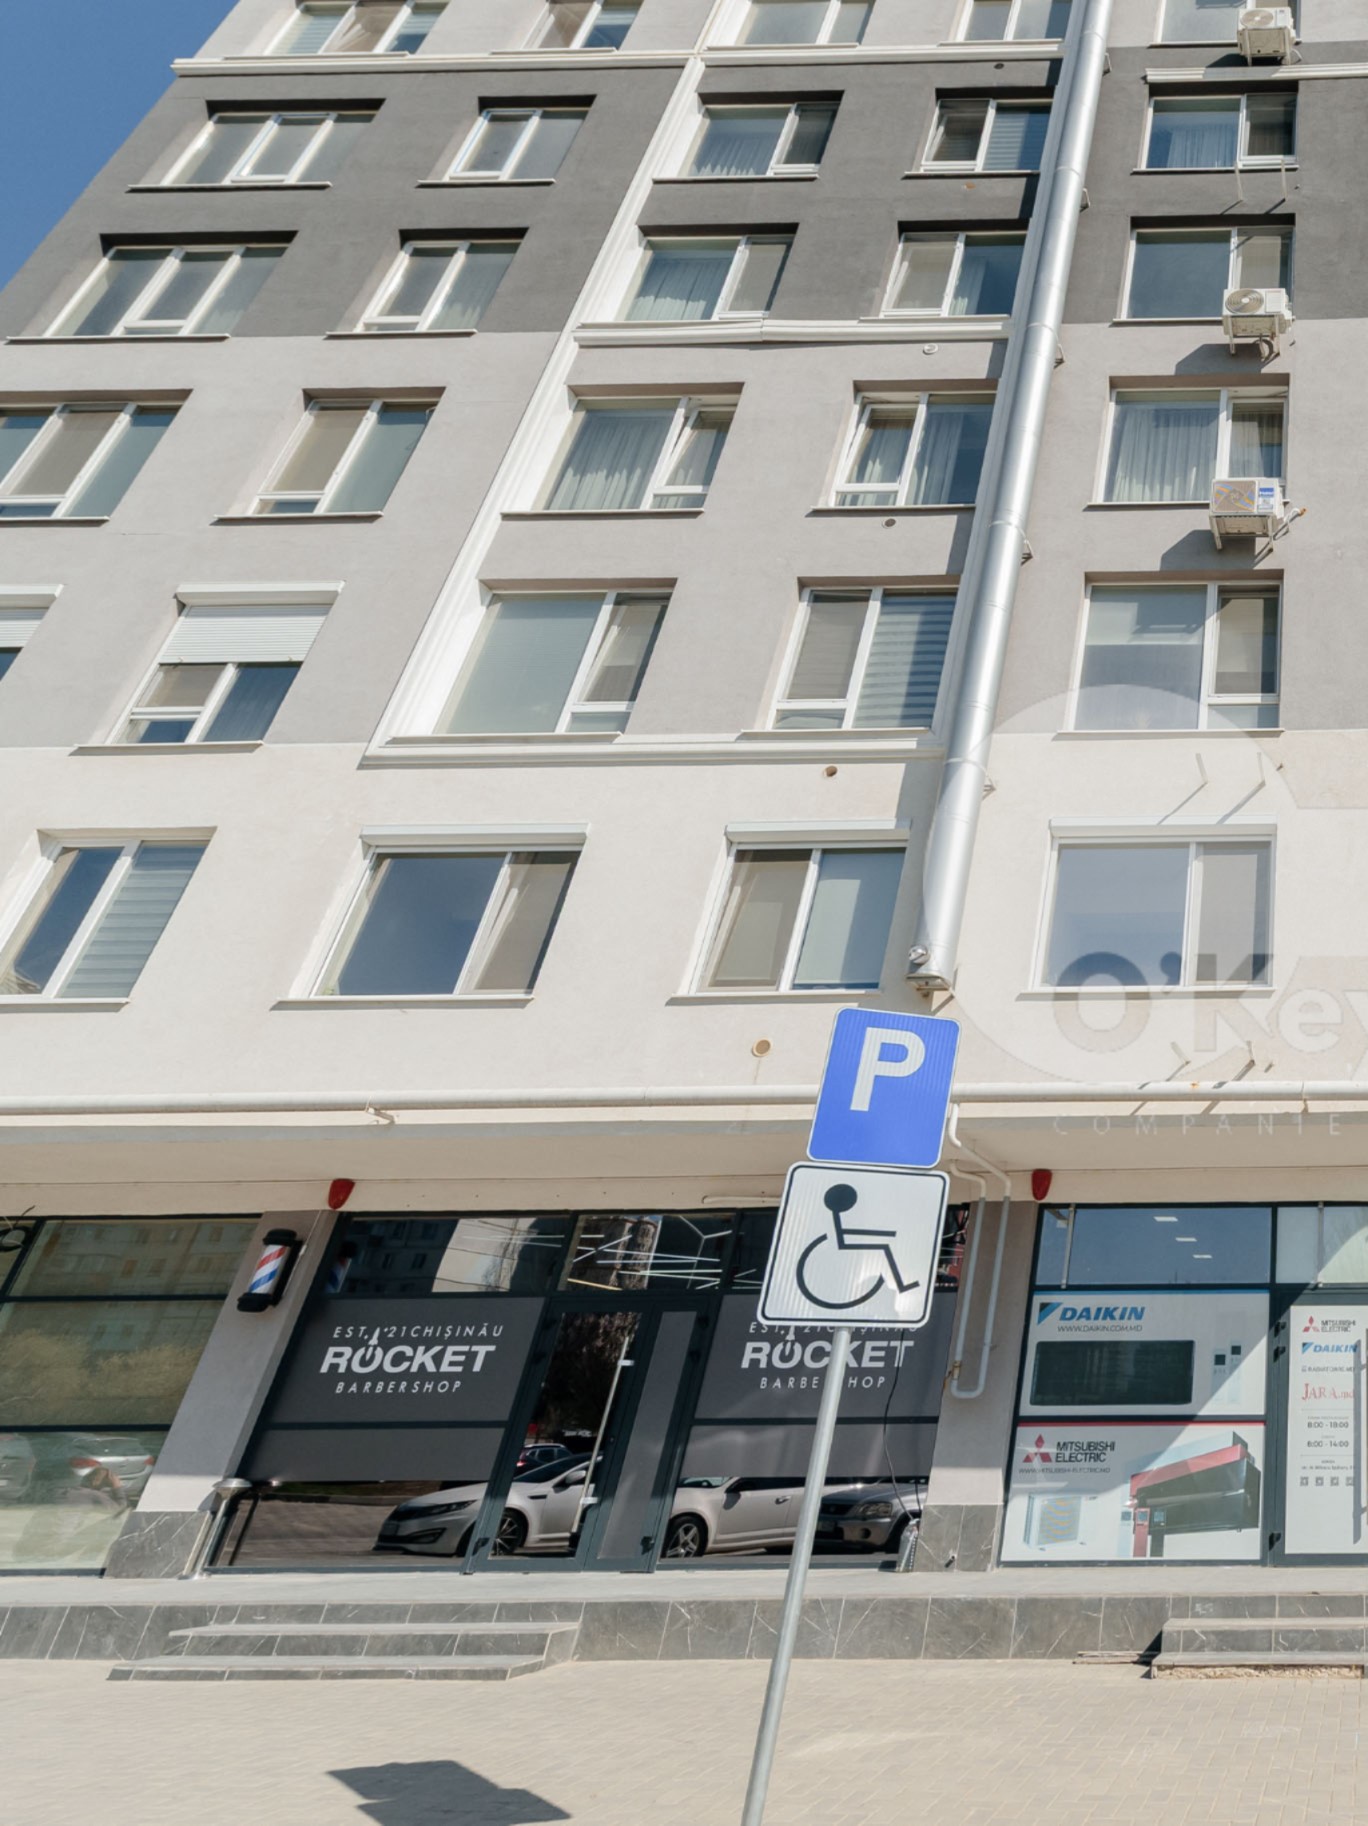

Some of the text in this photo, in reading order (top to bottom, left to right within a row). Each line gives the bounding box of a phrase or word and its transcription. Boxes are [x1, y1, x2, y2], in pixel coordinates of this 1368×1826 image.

[850, 1027, 926, 1111] P
[1059, 1307, 1145, 1321] DAIKIN
[1313, 1344, 1358, 1352] DAIKIN
[320, 1345, 496, 1373] ROCKET
[335, 1380, 462, 1394] BARBERSHOP
[760, 1376, 886, 1389] BARBEHOP
[1056, 1441, 1116, 1451] MITSUBISHI
[1056, 1452, 1107, 1463] ELECTRIC
